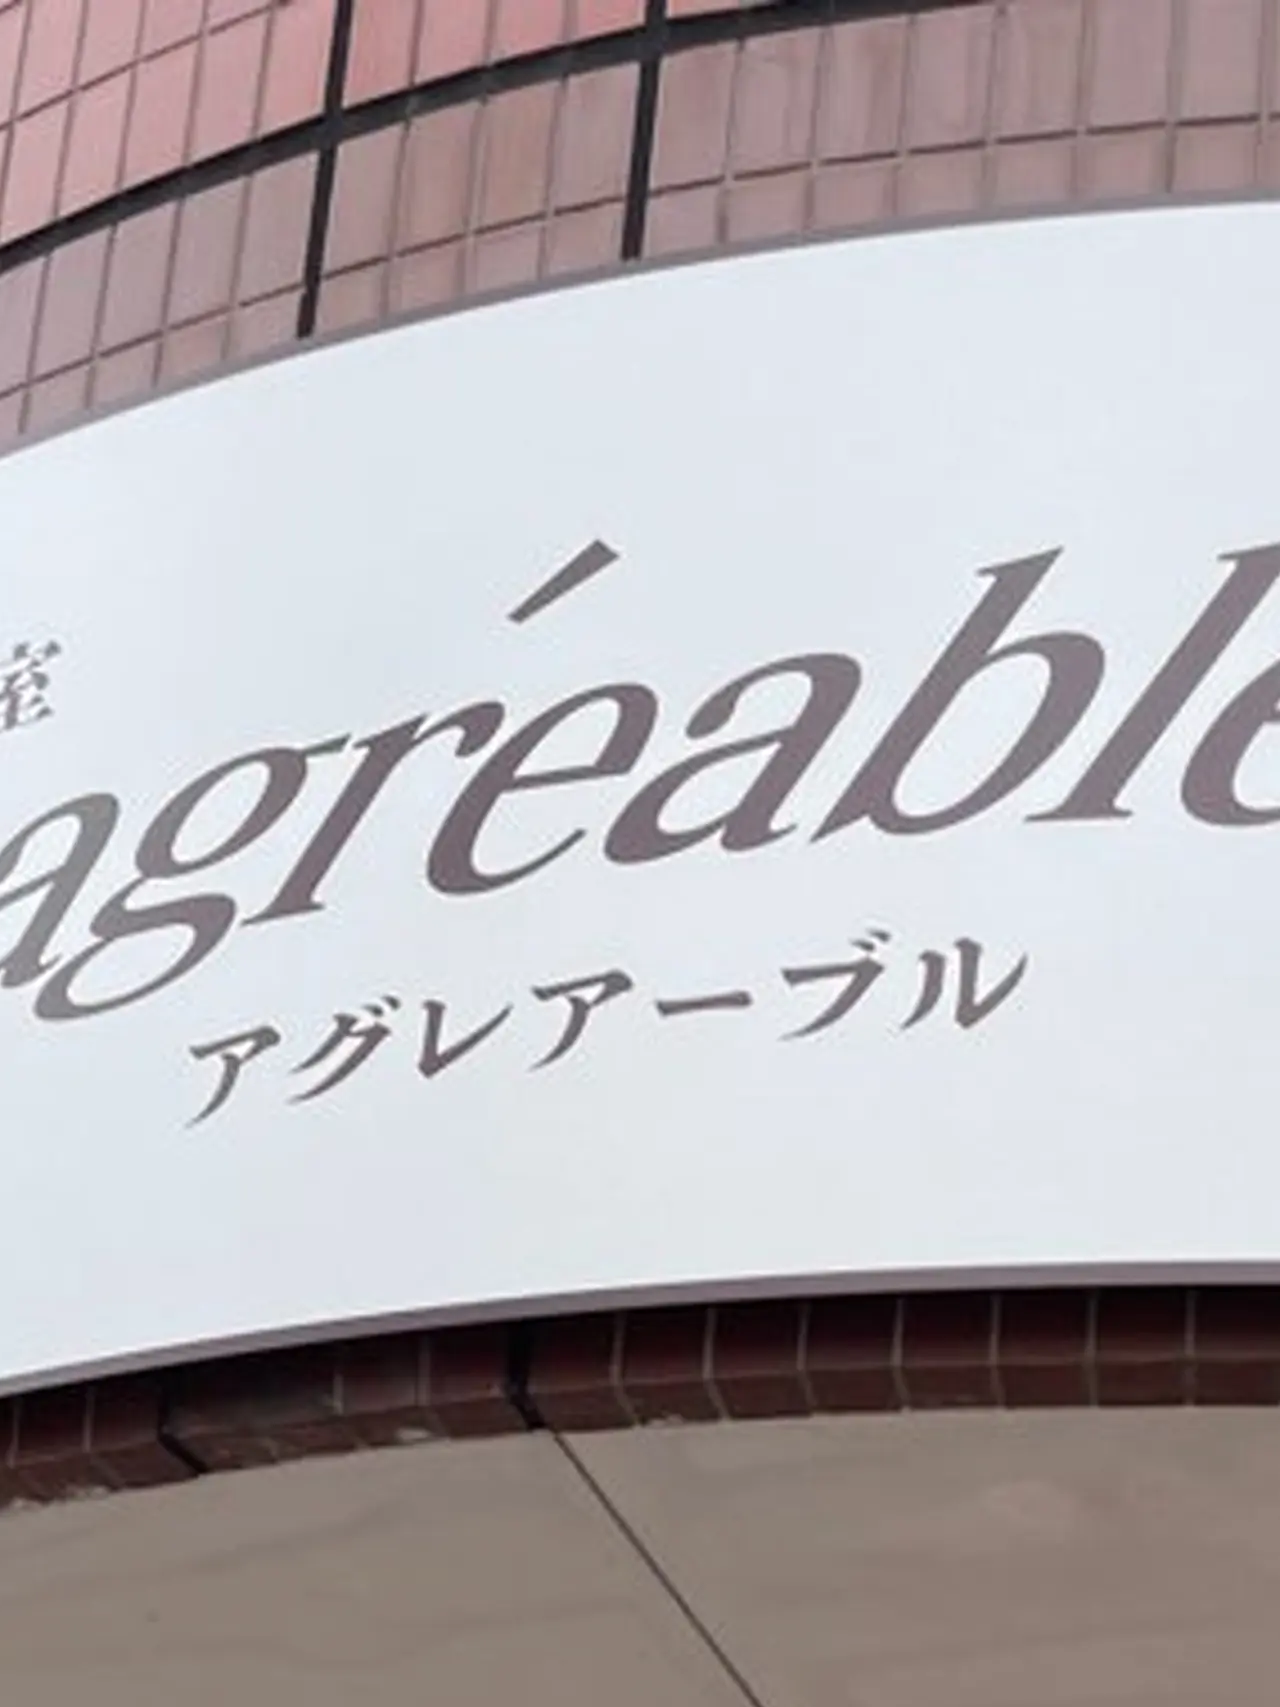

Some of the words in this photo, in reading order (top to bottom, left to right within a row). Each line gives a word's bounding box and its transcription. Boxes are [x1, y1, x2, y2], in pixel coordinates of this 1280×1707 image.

[186, 928, 1029, 1126] アグレアーブル
